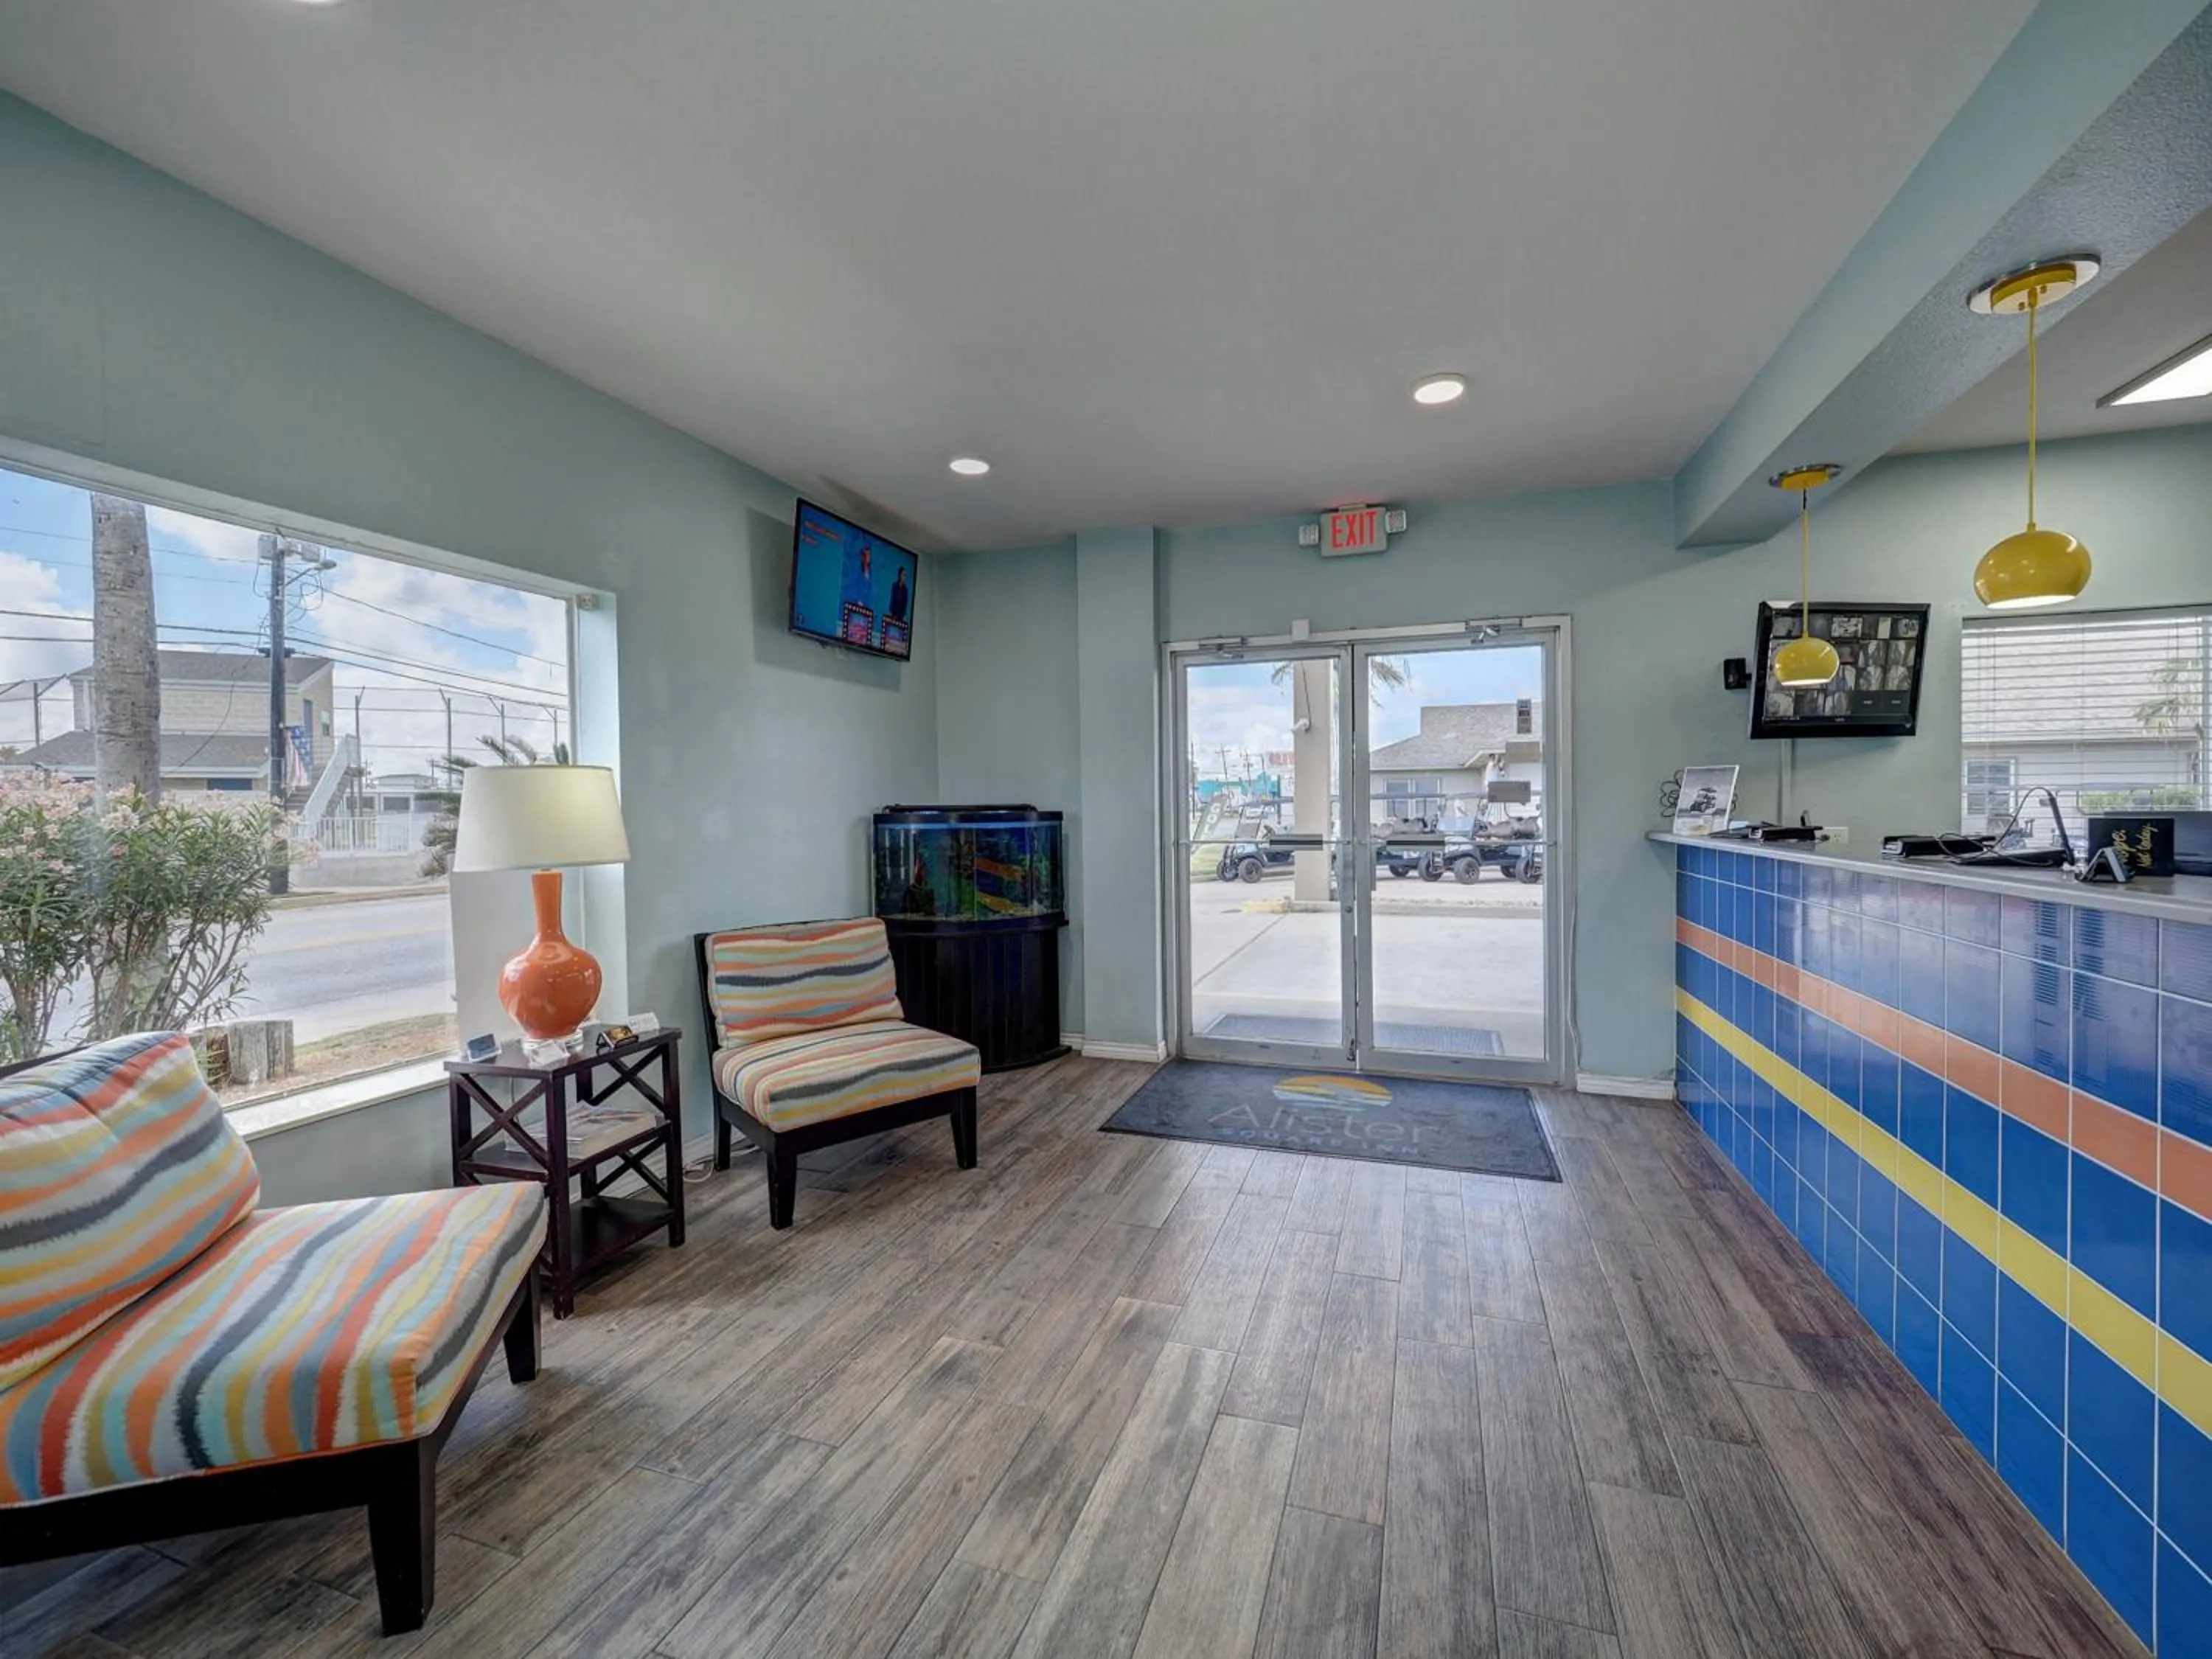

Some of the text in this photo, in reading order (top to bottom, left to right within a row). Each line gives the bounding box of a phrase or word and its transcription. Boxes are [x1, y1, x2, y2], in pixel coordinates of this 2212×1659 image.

[1331, 511, 1378, 549] EXIT
[1207, 1104, 1441, 1143] Alister
[1362, 1141, 1418, 1155] INN
